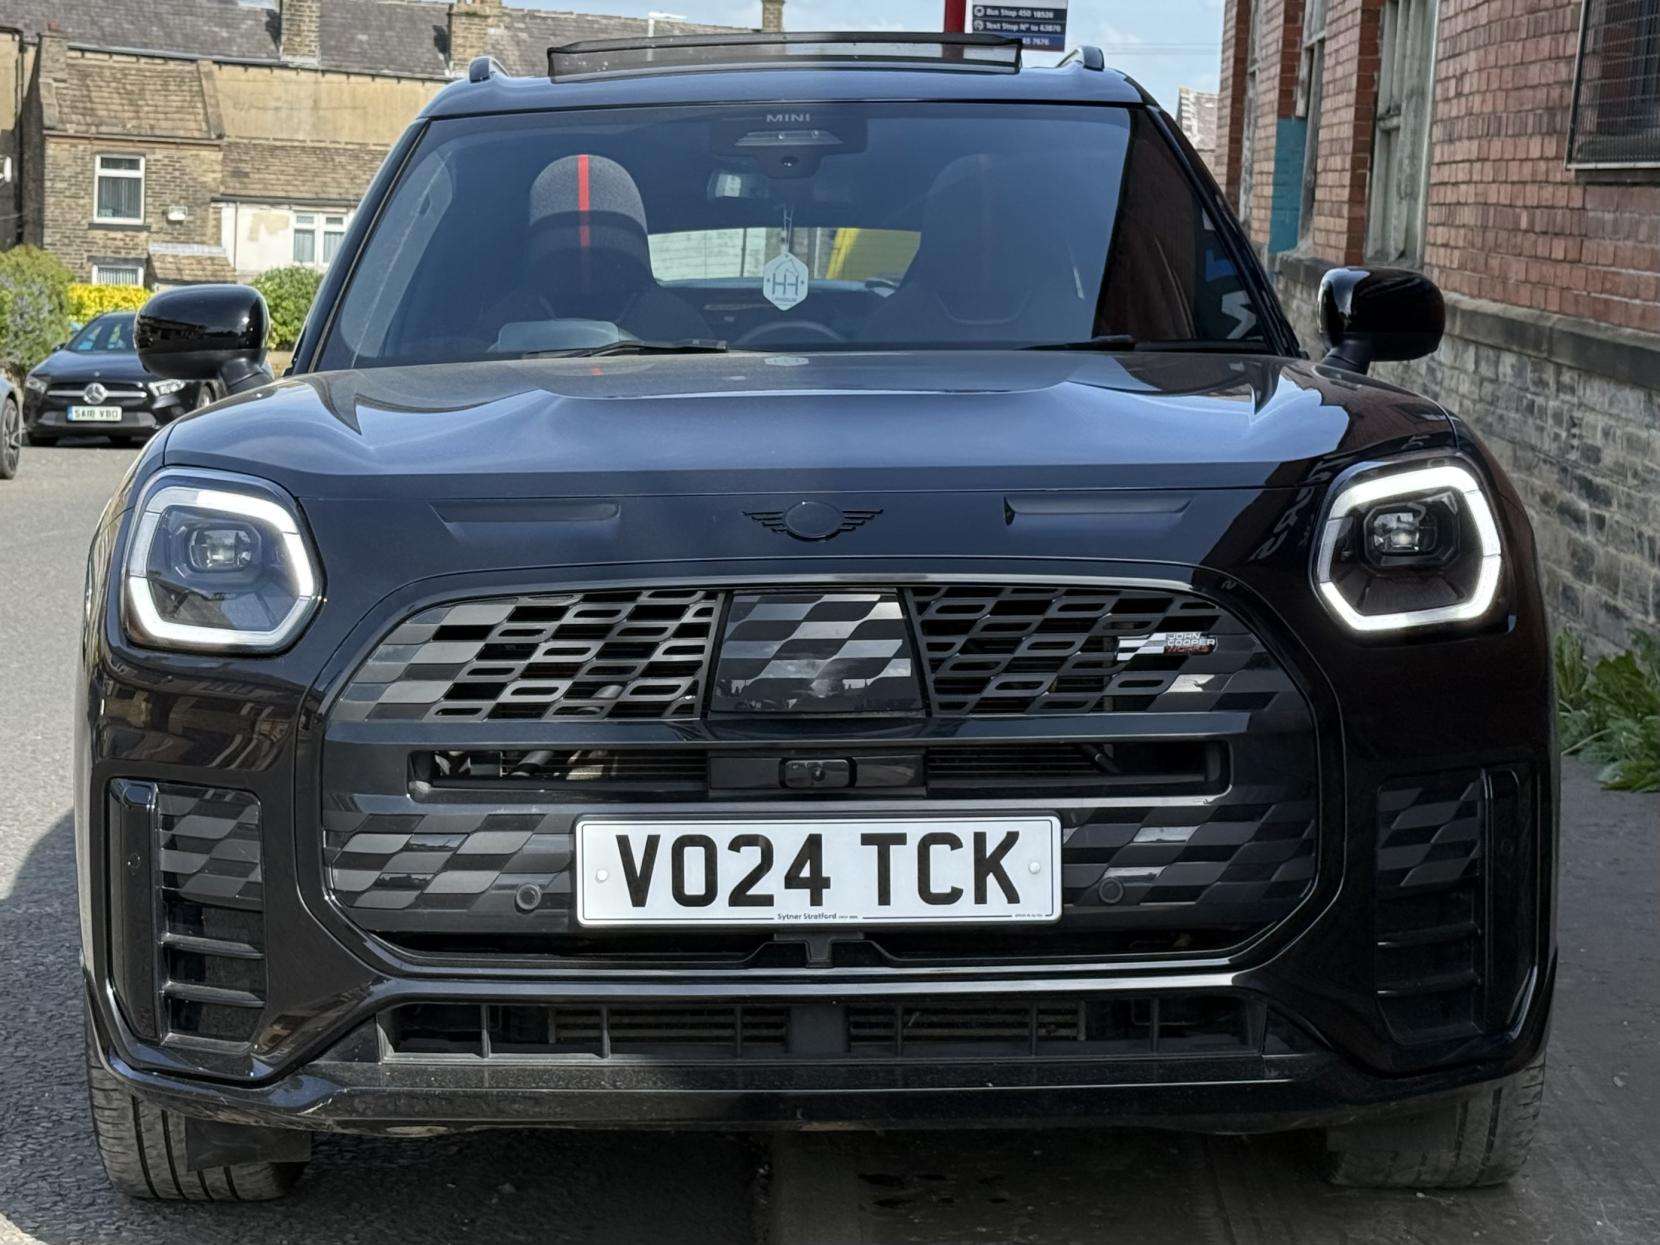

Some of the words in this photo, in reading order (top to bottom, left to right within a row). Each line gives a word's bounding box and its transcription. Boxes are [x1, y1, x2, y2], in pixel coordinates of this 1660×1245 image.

[986, 8, 999, 16] Bus
[1000, 9, 1018, 18] Stop
[1002, 23, 1018, 32] Stop
[766, 113, 810, 122] MINI
[1167, 631, 1201, 640] JOHN
[1167, 639, 1216, 647] COOPER
[615, 833, 831, 907] VO24
[860, 830, 1021, 905] TCK
[803, 912, 837, 920] Stratford
